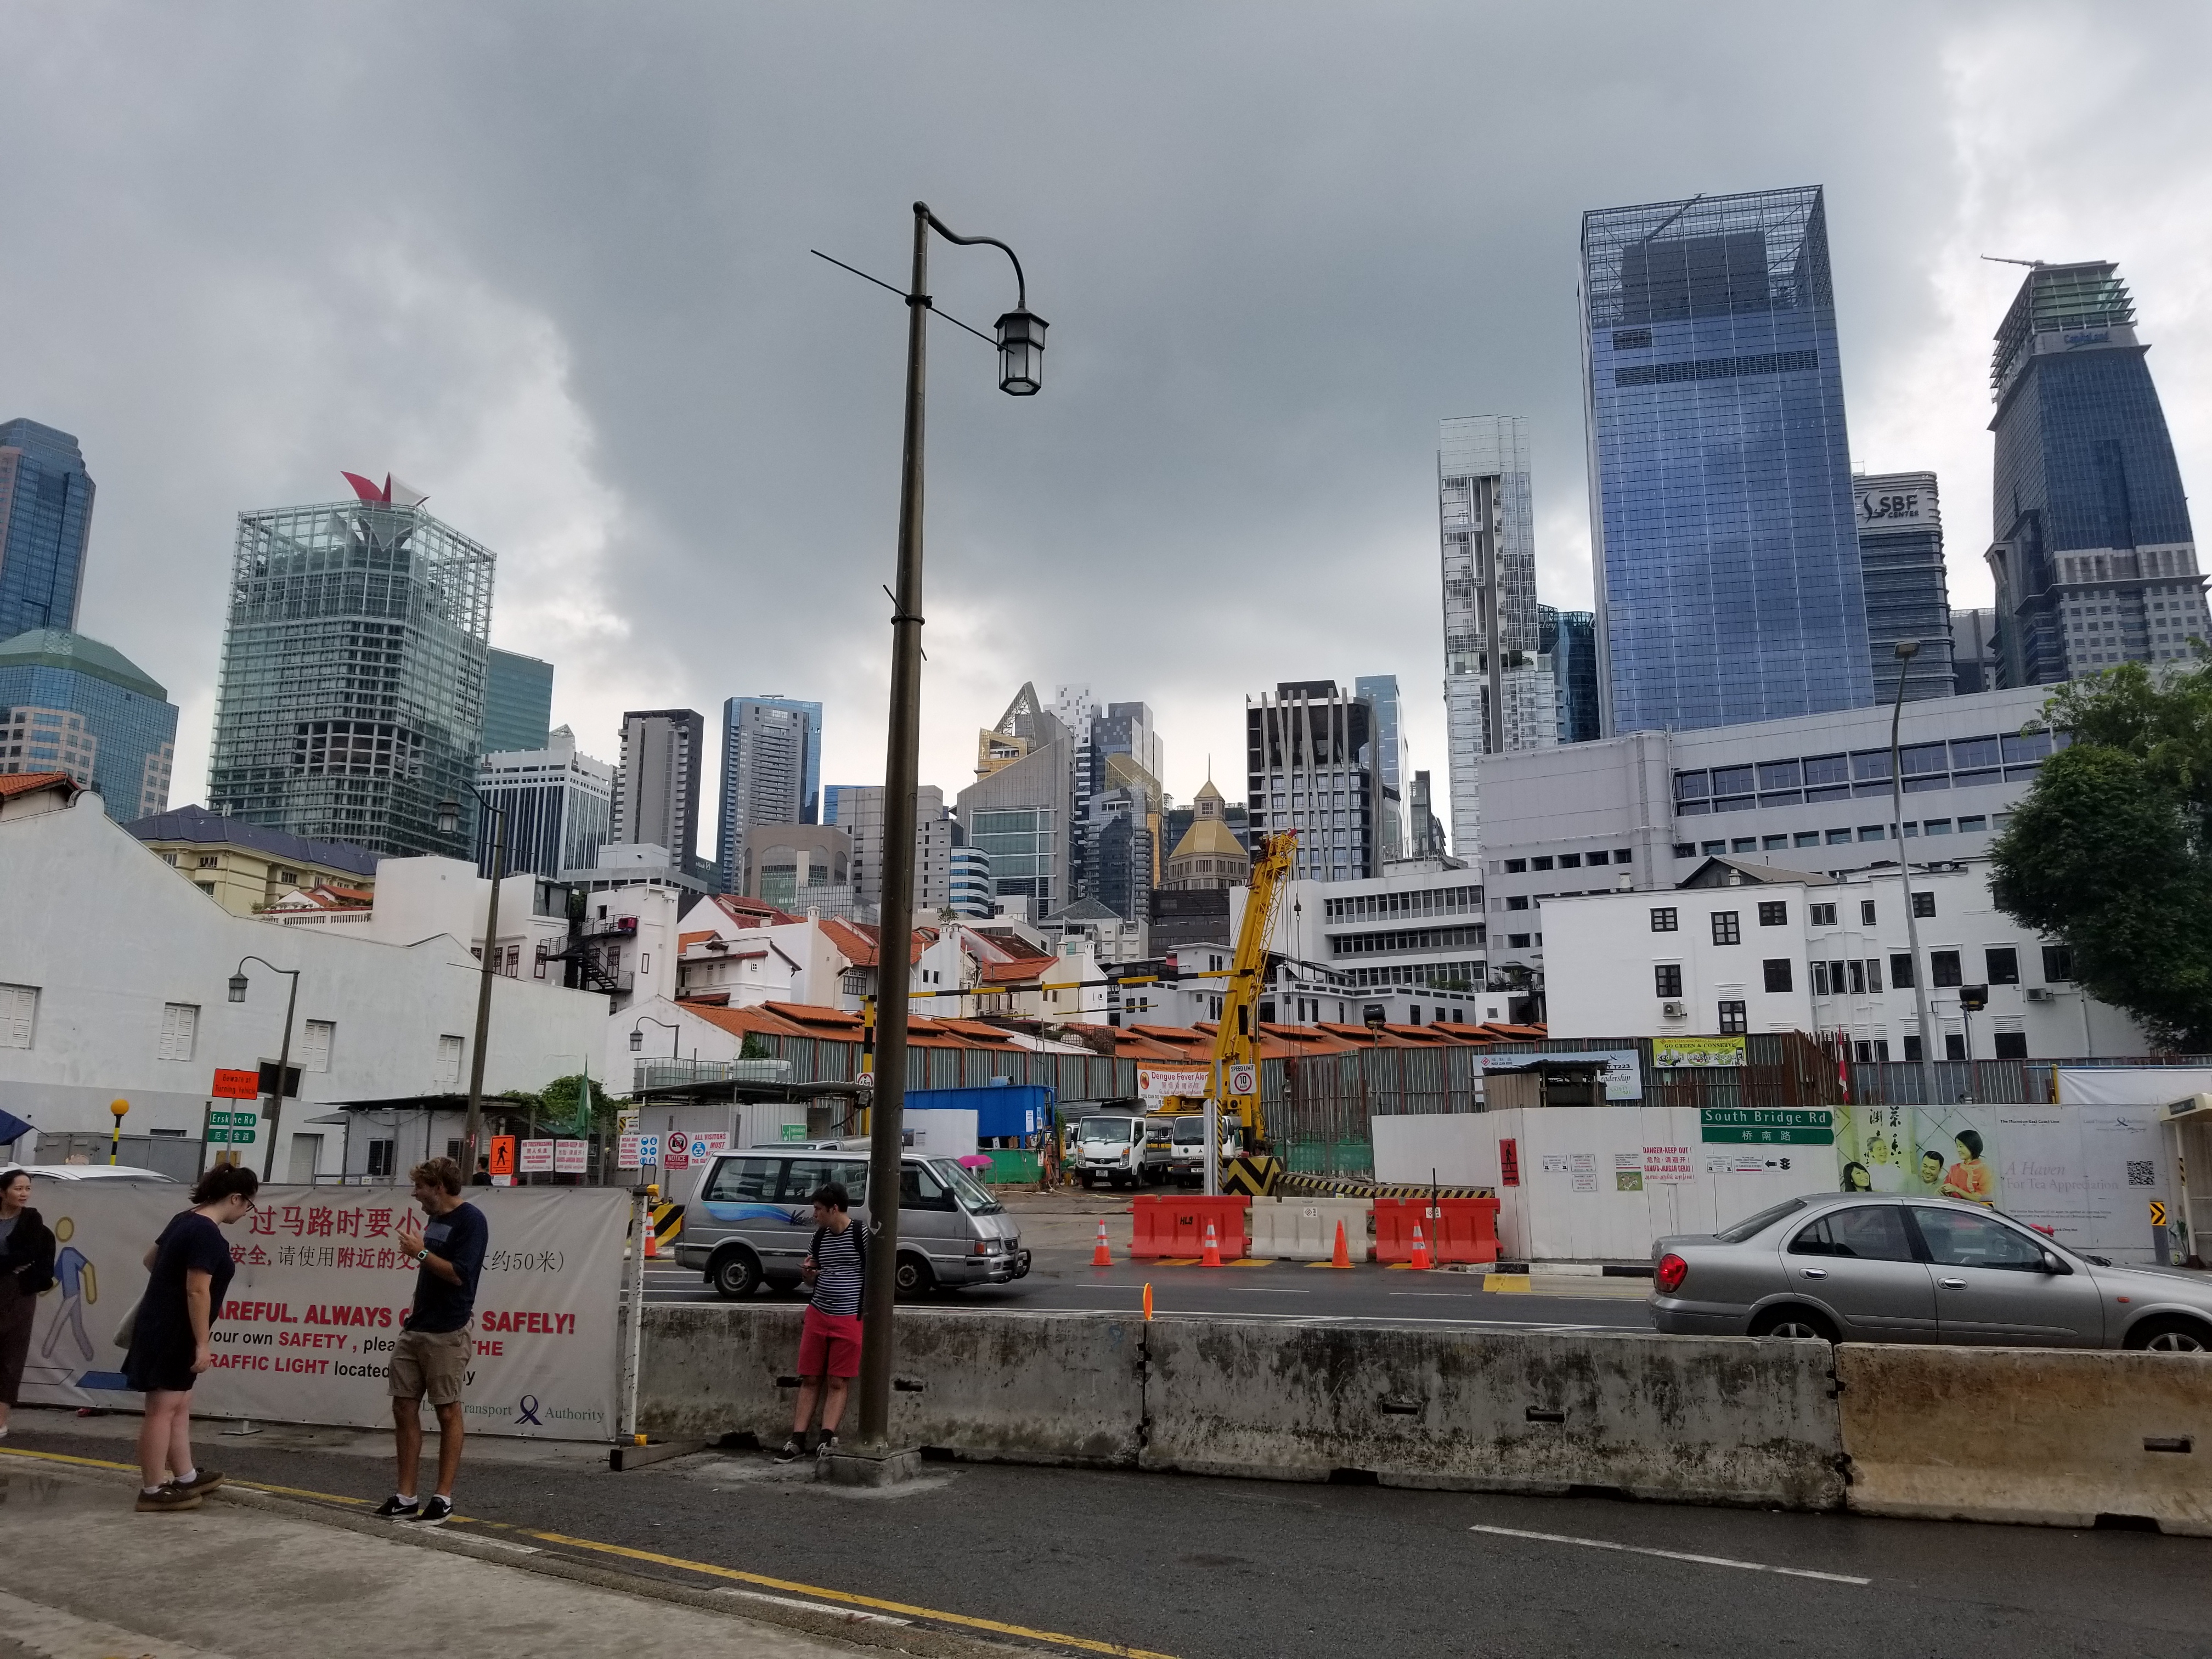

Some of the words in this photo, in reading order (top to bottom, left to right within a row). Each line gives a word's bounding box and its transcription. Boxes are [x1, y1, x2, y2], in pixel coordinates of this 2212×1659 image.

[1880, 494, 1918, 512] SBF
[223, 1074, 243, 1082] Beware
[1152, 1071, 1175, 1081] Dengue
[1195, 1073, 1208, 1081] Aler
[1239, 1076, 1246, 1085] 10
[1600, 1074, 1630, 1083] eadership
[215, 1085, 235, 1094] Turning
[238, 1086, 256, 1094] Vehicle
[212, 1114, 241, 1124] Erskne
[244, 1115, 253, 1124] Rd
[1706, 1110, 1747, 1121] South
[1754, 1111, 1802, 1125] Bridge
[1809, 1112, 1826, 1124] Rd
[1742, 1130, 1791, 1141] 桥南路
[2005, 1161, 2016, 1175] A
[2022, 1161, 2066, 1175] Haven
[2007, 1178, 2023, 1189] For
[2027, 1178, 2045, 1189] Tea
[2050, 1179, 2119, 1193] Appreciation
[249, 1205, 429, 1238] 过马路时要小
[1180, 1216, 1193, 1225] HLS
[219, 1301, 297, 1323] REFUL.
[304, 1305, 392, 1328] ALWAYS
[482, 1311, 575, 1334] SAFELY!
[243, 1333, 273, 1345] own
[279, 1332, 348, 1348] SAFETY
[363, 1336, 395, 1354] plea
[472, 1340, 503, 1356] HE
[209, 1353, 269, 1370] RAFFIC
[274, 1358, 329, 1374] LIGHT
[334, 1361, 389, 1378] located
[545, 1407, 604, 1423] Authority
